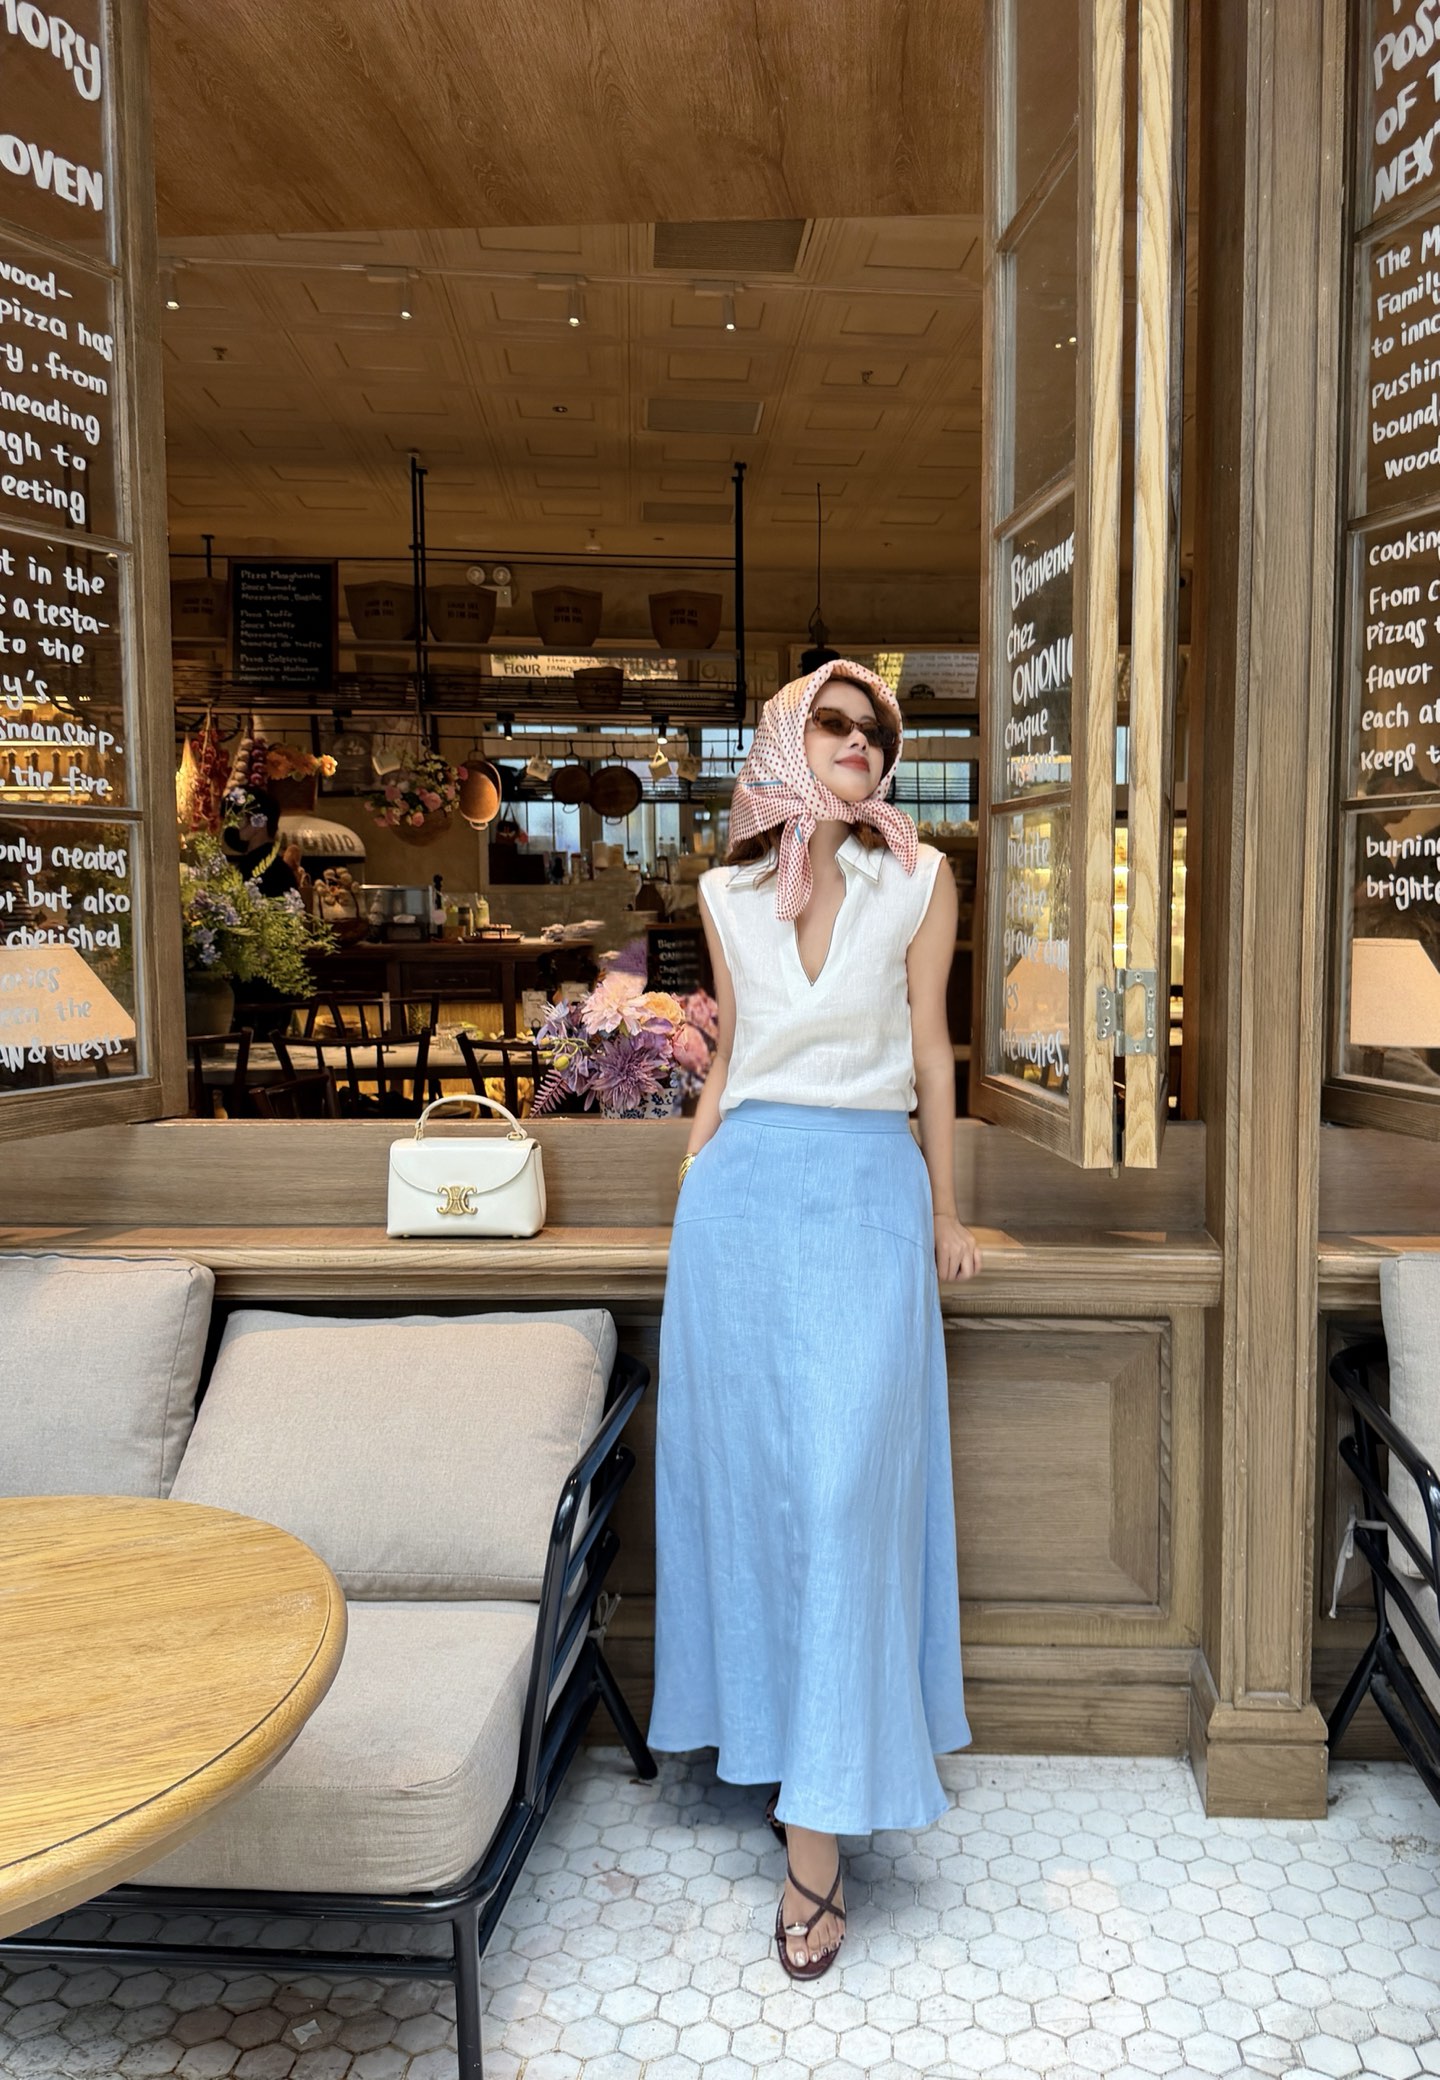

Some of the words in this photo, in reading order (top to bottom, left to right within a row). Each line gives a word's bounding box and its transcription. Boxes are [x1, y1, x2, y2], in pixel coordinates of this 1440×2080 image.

[1373, 0, 1440, 91] POS
[1375, 81, 1418, 145] OF
[0, 134, 103, 211] OVEN
[1373, 118, 1440, 214] NEX
[1376, 245, 1411, 279] The
[0, 297, 67, 340] pizza
[77, 322, 114, 362] has
[1371, 336, 1394, 359] to
[44, 351, 108, 396] from
[0, 386, 100, 446] neading
[1372, 393, 1440, 444] bound
[50, 443, 87, 472] to
[28, 556, 52, 585] in
[63, 565, 105, 596] the
[13, 597, 31, 620] a
[33, 598, 110, 635] testa-
[1370, 586, 1420, 615] From
[38, 636, 85, 664] the
[1007, 621, 1036, 663] chez
[504, 663, 541, 676] FLOUR
[1366, 661, 1433, 694] flavor
[1004, 708, 1048, 754] chaque
[1362, 701, 1409, 731] each
[12, 765, 53, 790] the
[61, 765, 110, 797] fire
[51, 844, 127, 879] creates
[27, 879, 73, 913] but
[84, 888, 131, 915] also
[6, 924, 121, 951] cherished
[55, 997, 92, 1022] the
